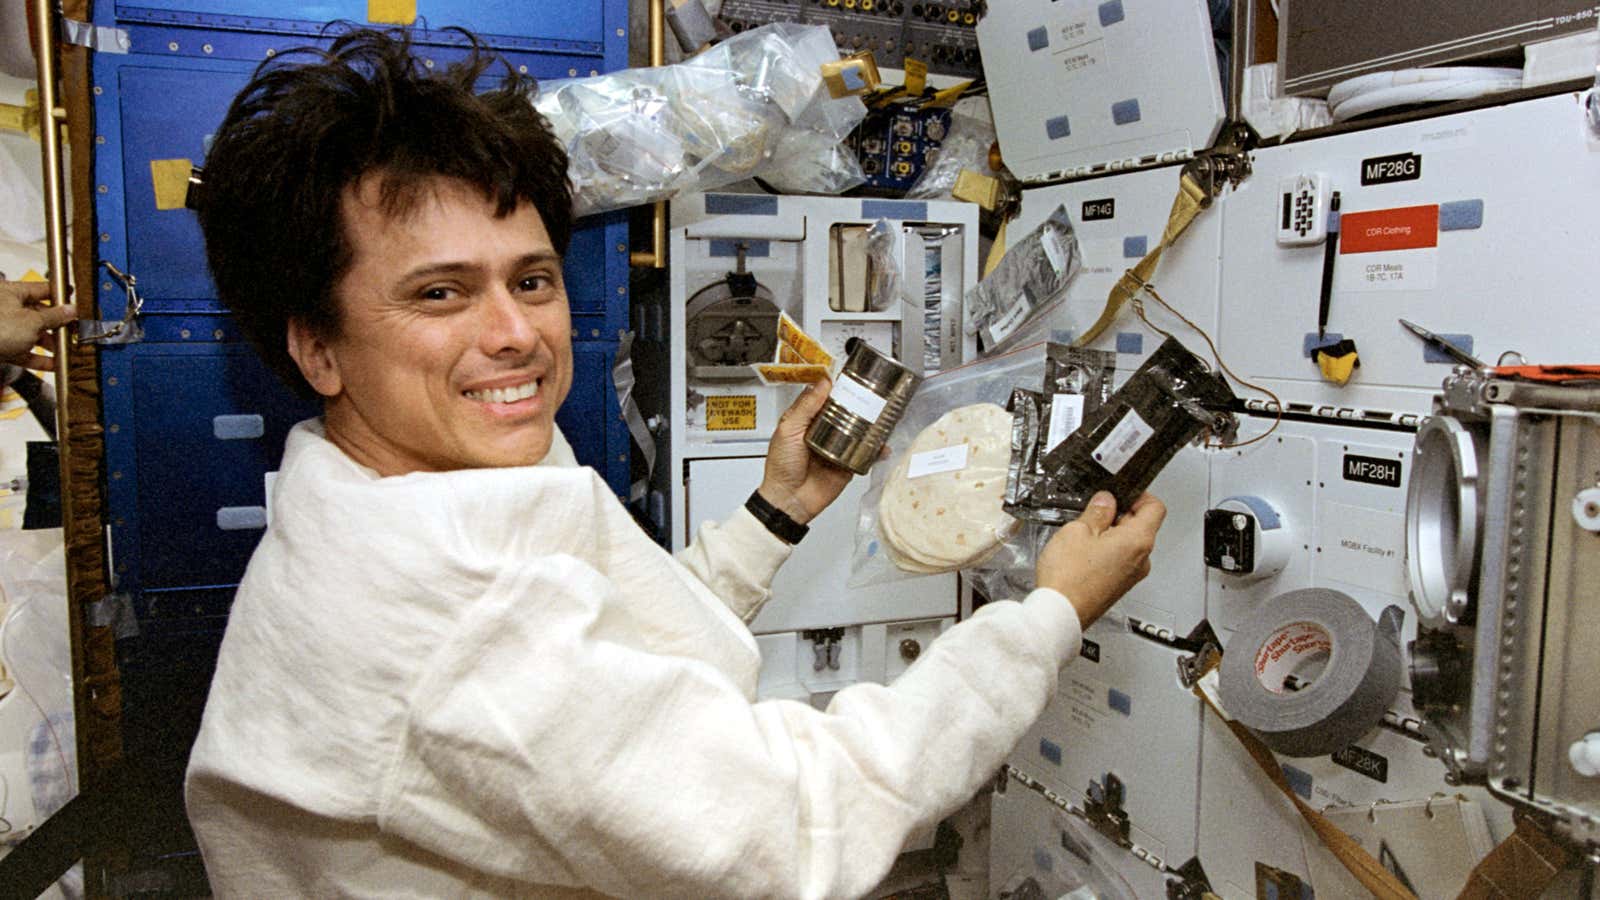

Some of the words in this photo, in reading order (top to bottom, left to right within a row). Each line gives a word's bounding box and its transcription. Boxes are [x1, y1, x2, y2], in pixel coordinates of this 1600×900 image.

[1366, 159, 1415, 179] MF28G
[1084, 203, 1112, 216] MF14G
[1366, 228, 1382, 237] CDR
[1383, 226, 1411, 236] Clothing
[722, 416, 740, 424] USE
[1348, 461, 1396, 481] MF28H
[1258, 631, 1289, 673] Shurtape
[1271, 633, 1313, 662] Shurtape
